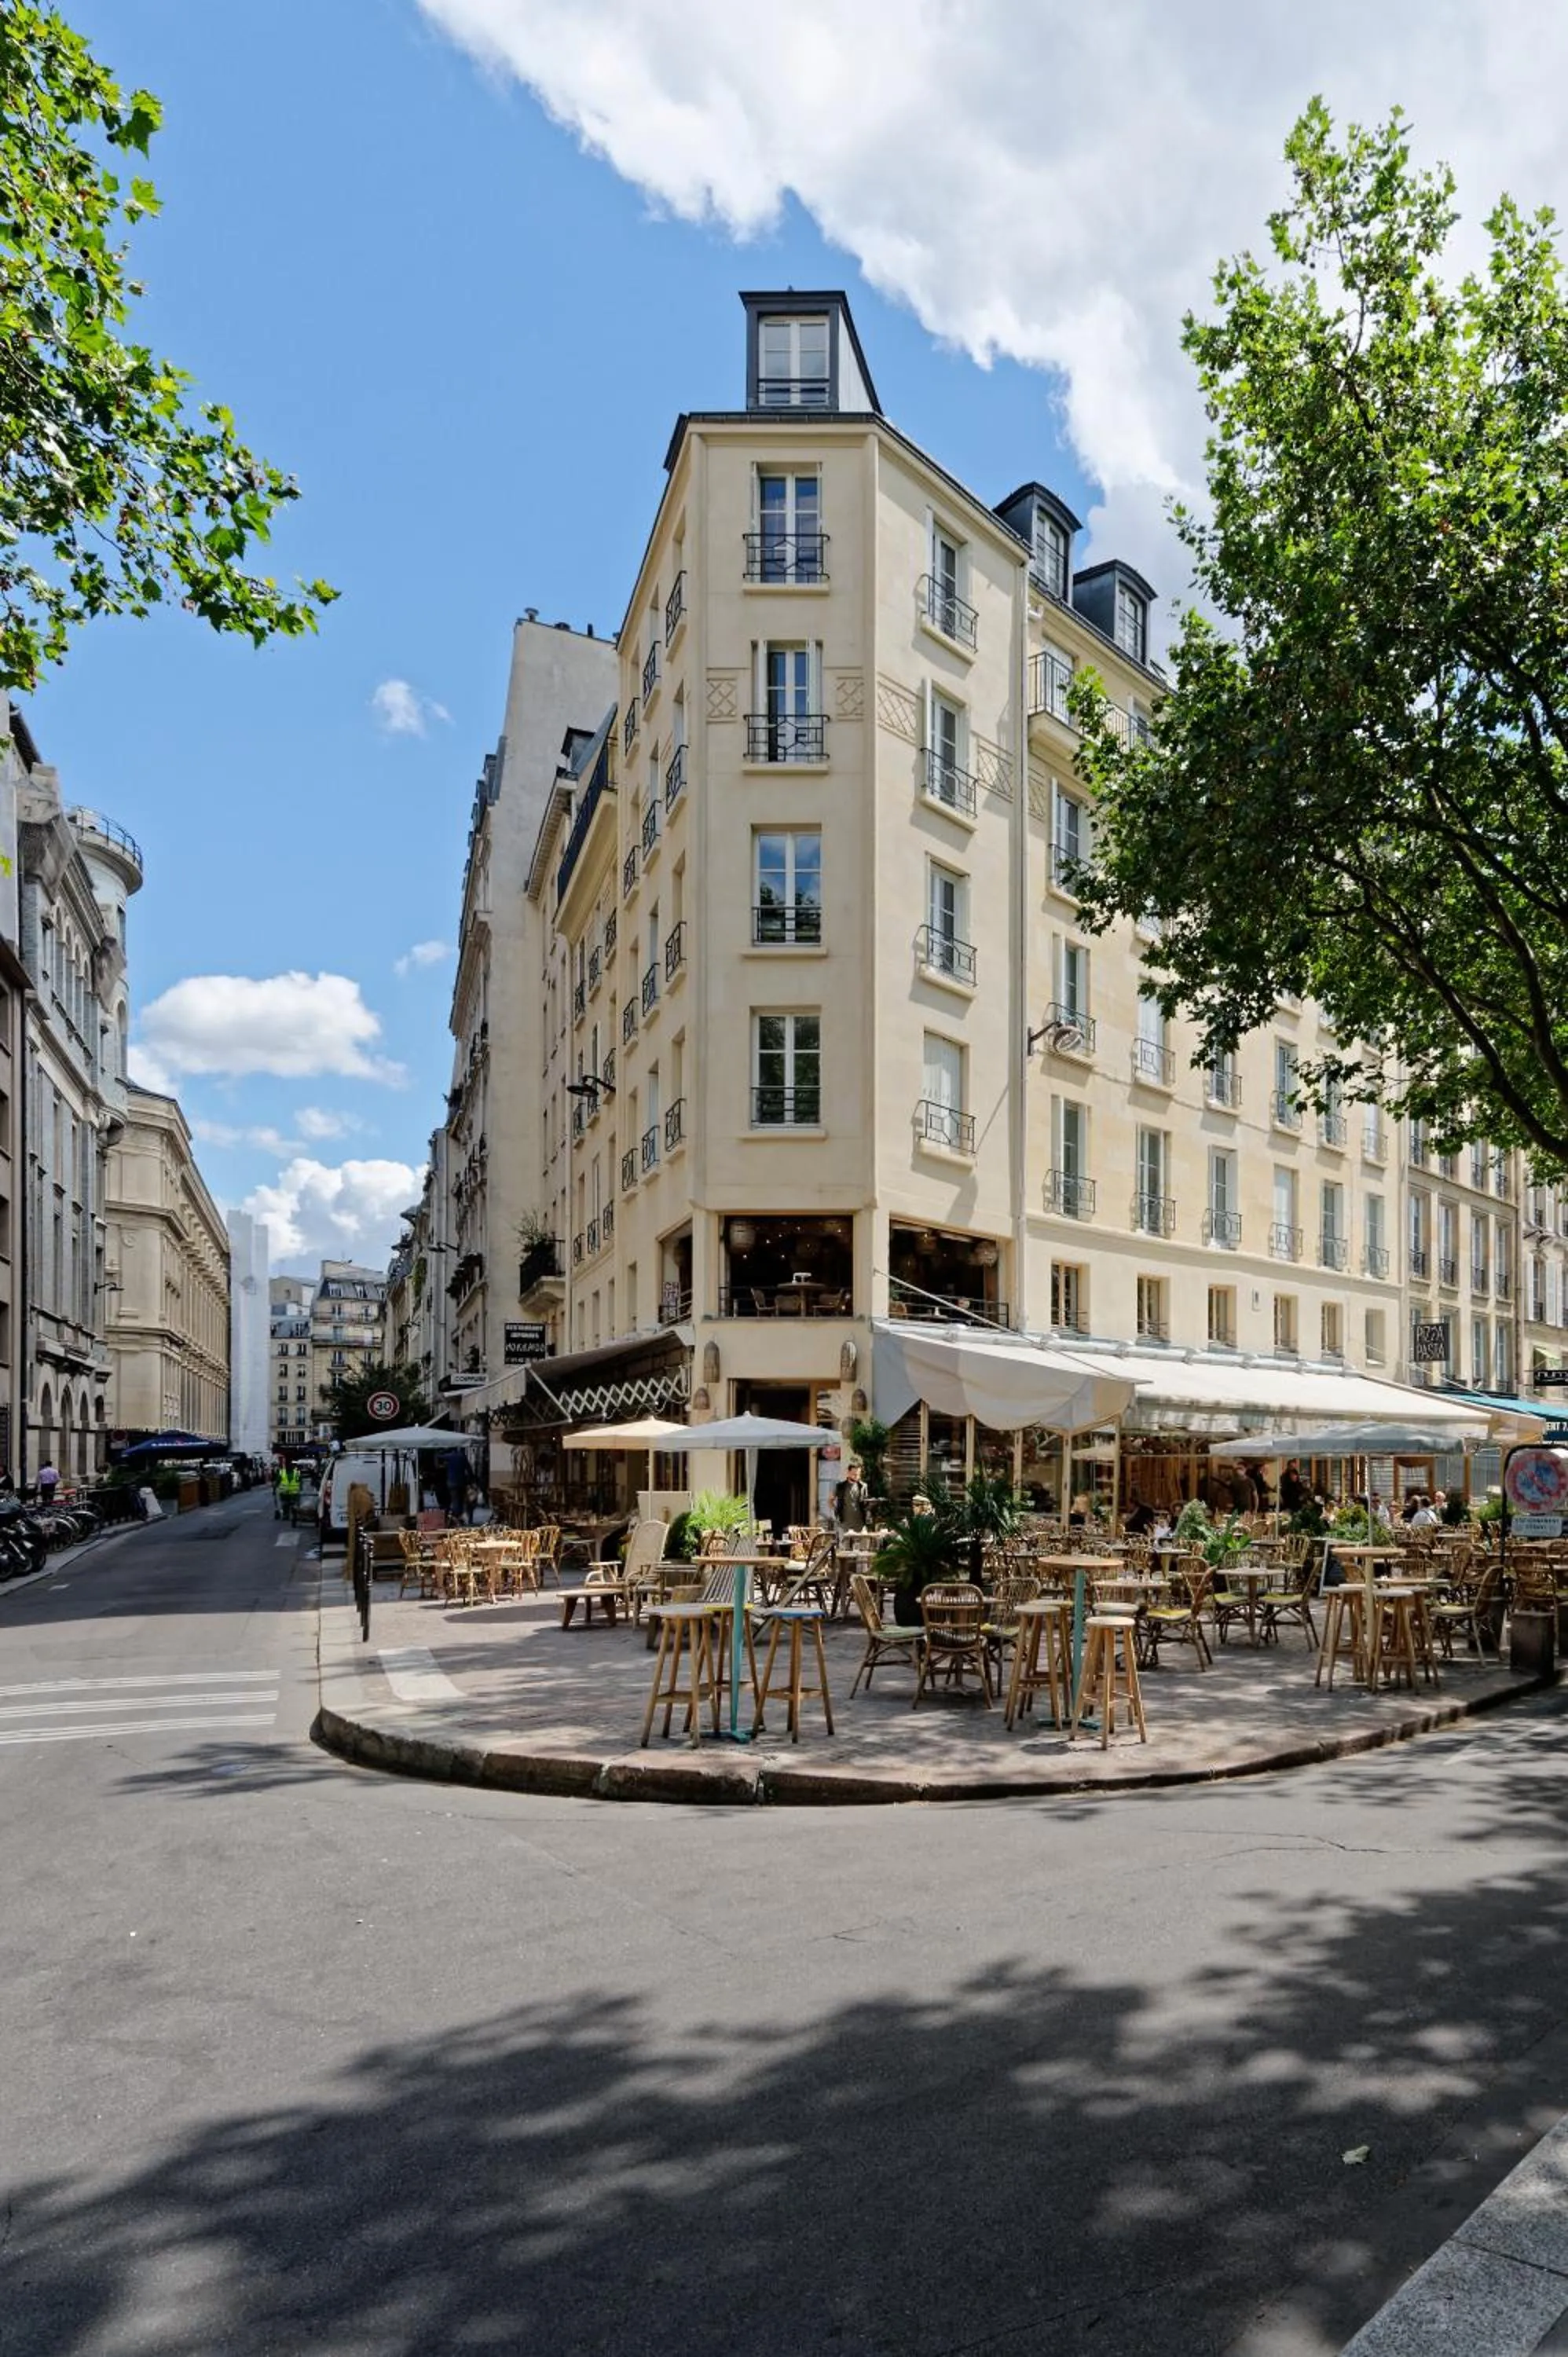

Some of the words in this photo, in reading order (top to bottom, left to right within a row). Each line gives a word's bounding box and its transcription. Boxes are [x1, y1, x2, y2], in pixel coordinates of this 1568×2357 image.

[1416, 1325, 1444, 1341] PIZZA
[1416, 1343, 1444, 1360] PASTA
[376, 1401, 392, 1412] 30
